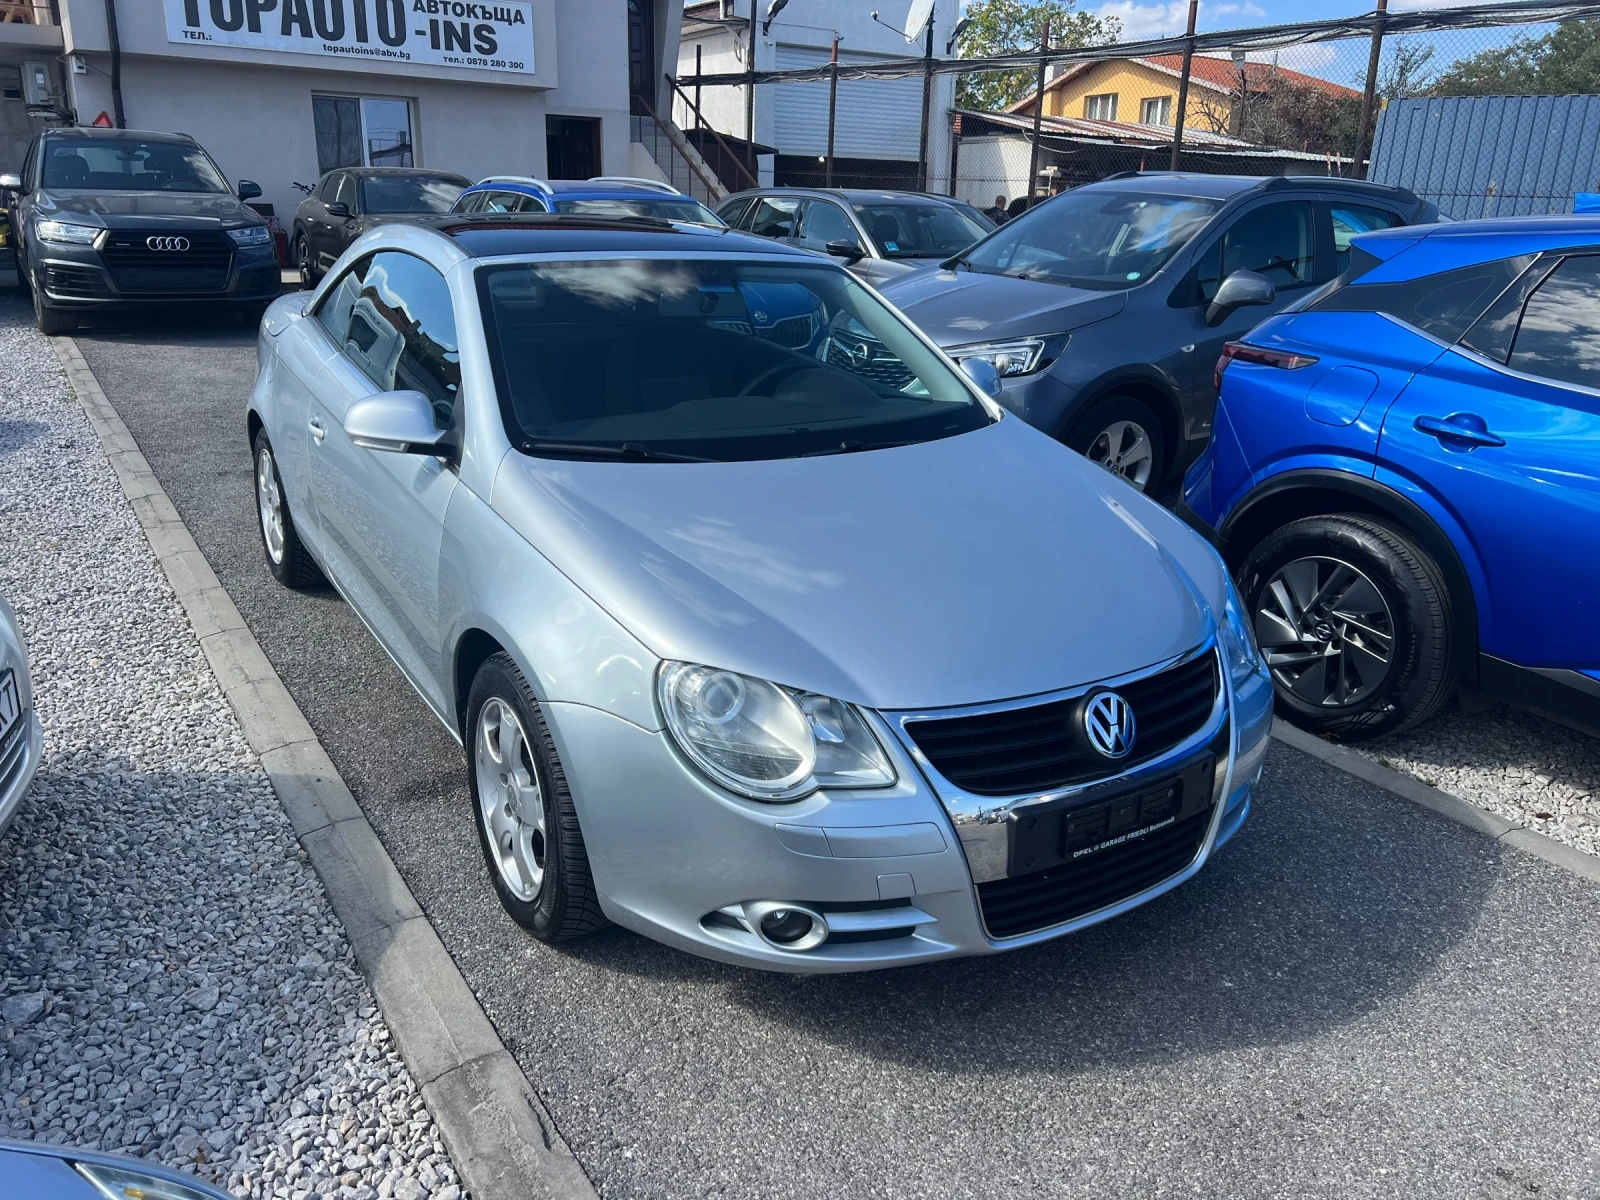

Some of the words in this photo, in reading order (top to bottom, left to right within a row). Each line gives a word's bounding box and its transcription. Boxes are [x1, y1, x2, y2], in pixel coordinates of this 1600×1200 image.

[413, 0, 525, 26] АВТОКЪЩА
[323, 43, 410, 60] topautoins@abv.bg
[443, 56, 465, 64] тел.:
[467, 57, 488, 66] 0878
[490, 59, 506, 68] 280
[508, 61, 524, 70] 300
[1073, 847, 1093, 858] OPEL
[1100, 835, 1126, 849] GARAGE
